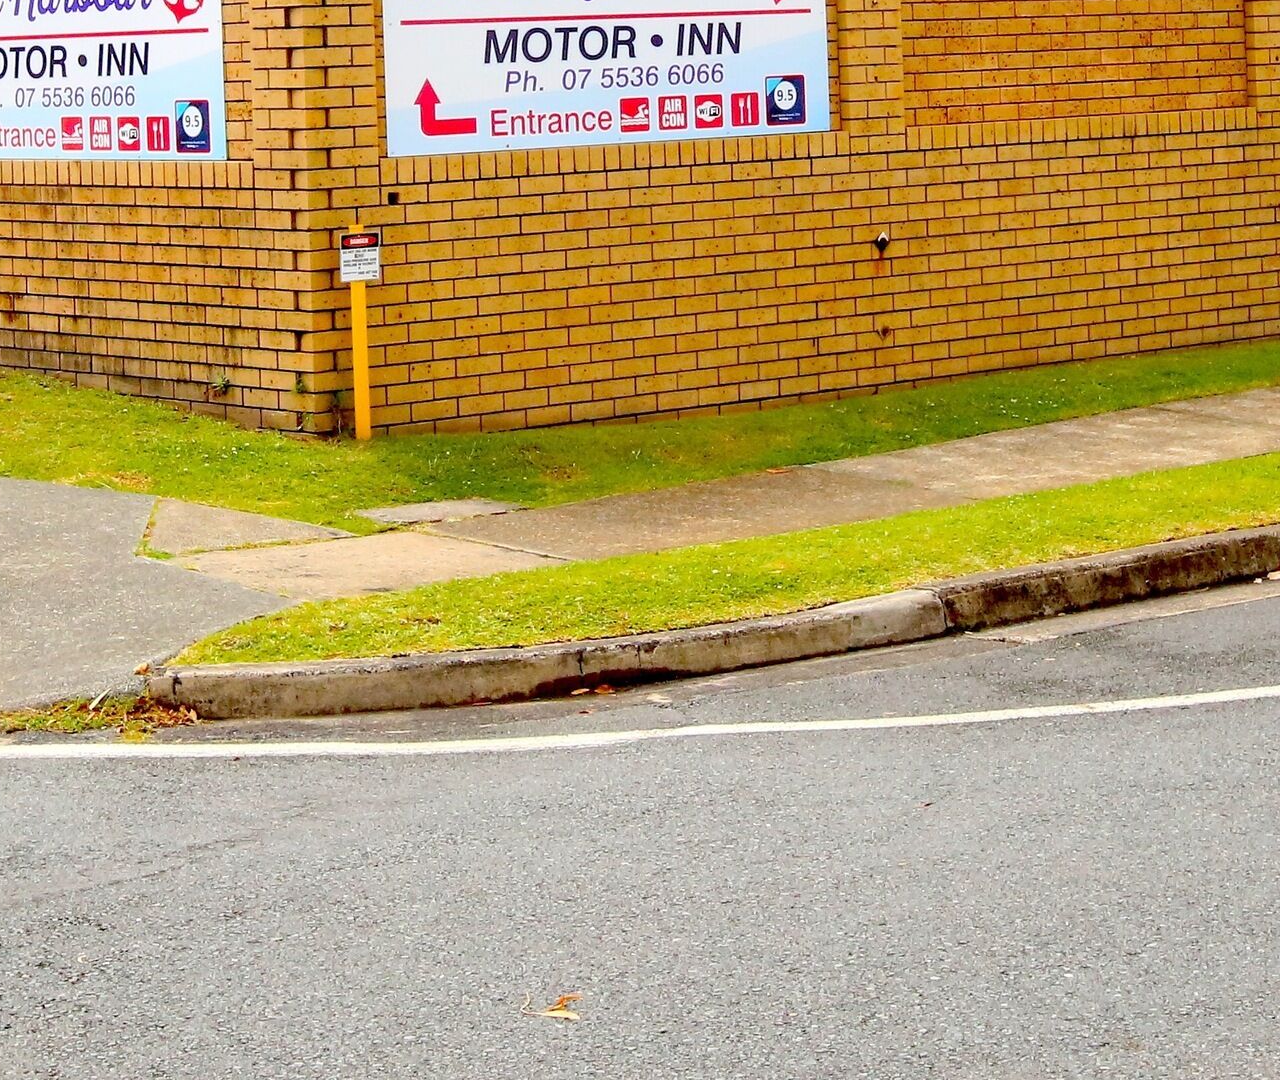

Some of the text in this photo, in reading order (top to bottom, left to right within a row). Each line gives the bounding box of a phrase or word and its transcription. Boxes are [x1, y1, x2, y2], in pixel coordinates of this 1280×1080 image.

[484, 22, 742, 64] MOTOR INN
[97, 42, 149, 77] INN
[505, 63, 725, 93] Ph. 07 5536 6066
[15, 87, 37, 108] 07
[41, 87, 85, 108] 5536
[91, 85, 135, 107] 6066
[776, 89, 794, 102] 9.5
[664, 99, 682, 112] AIR
[93, 119, 108, 133] AIR
[184, 115, 200, 128] 9.5
[490, 108, 612, 137] Entrance
[662, 113, 685, 128] CON
[92, 134, 110, 149] CON
